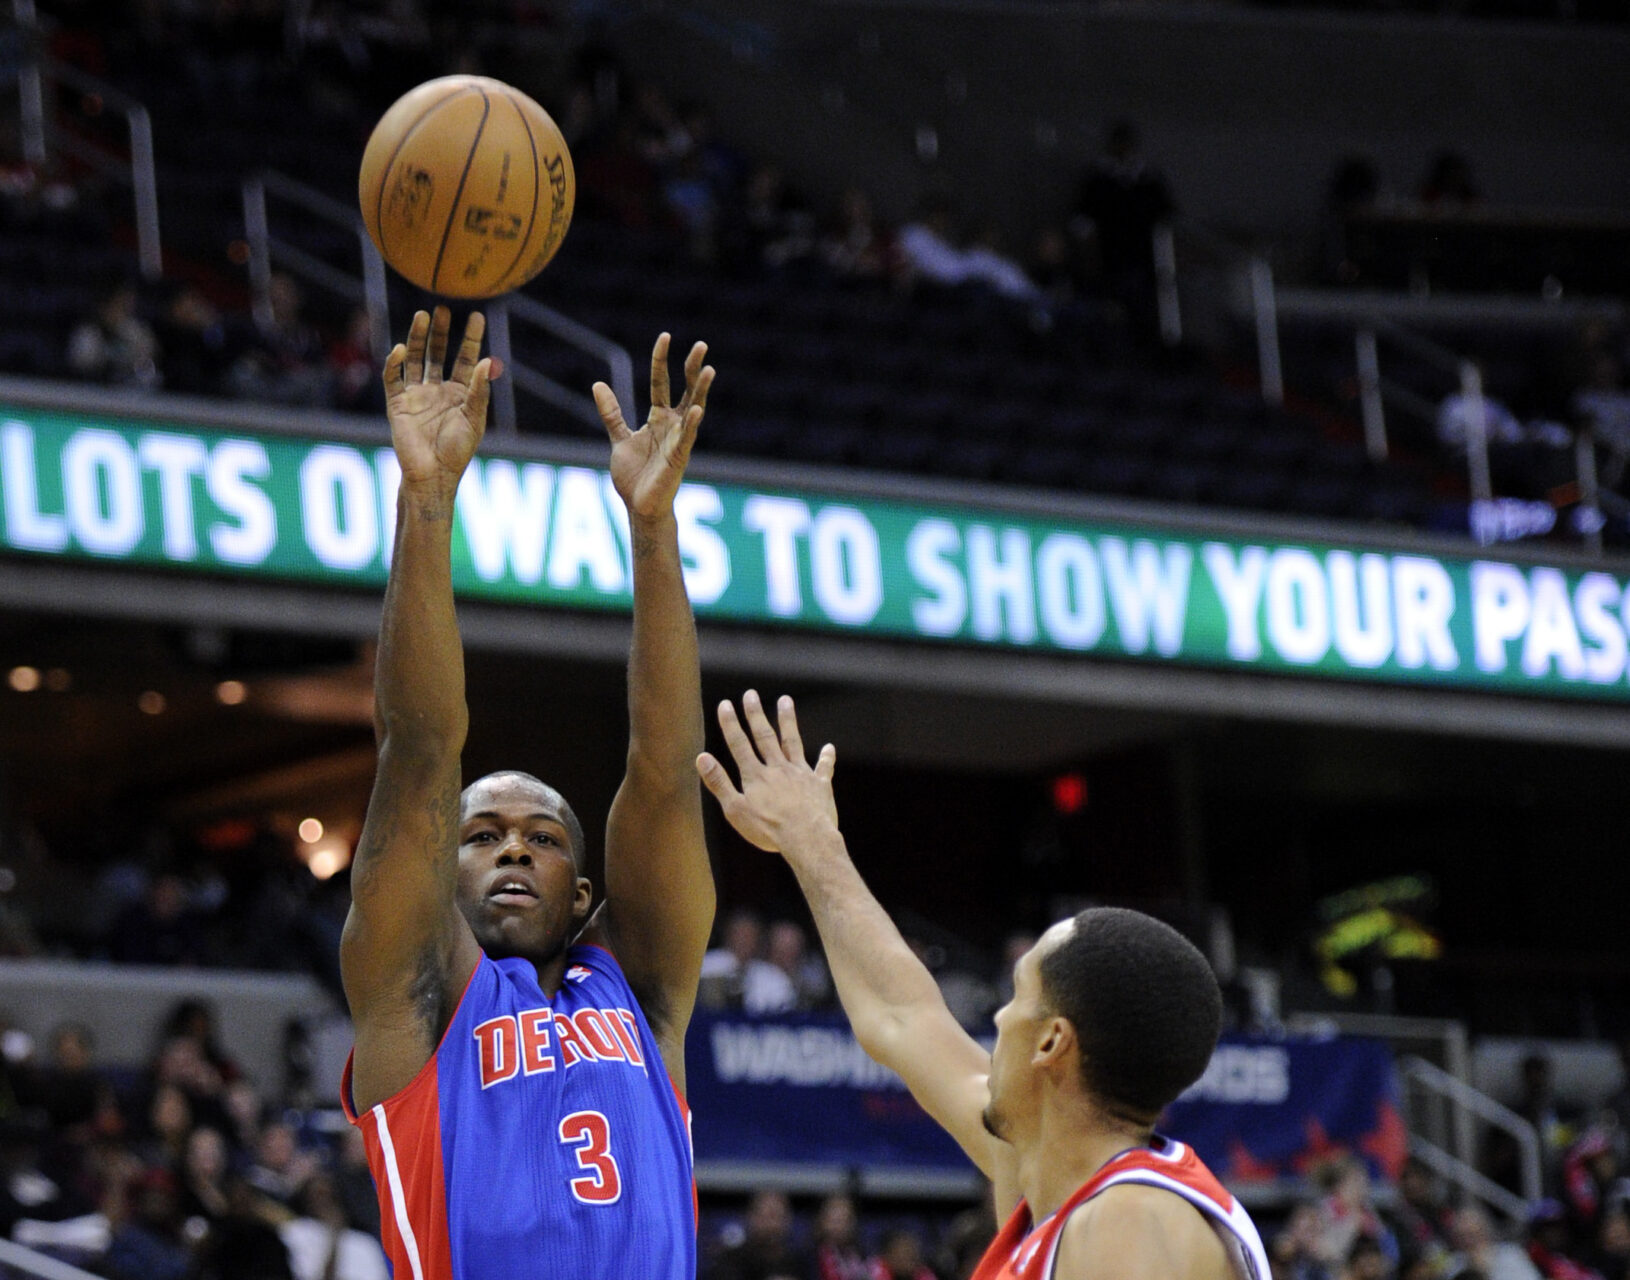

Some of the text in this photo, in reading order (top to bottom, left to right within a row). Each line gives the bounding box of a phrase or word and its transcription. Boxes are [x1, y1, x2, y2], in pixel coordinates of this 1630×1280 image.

[0, 421, 278, 565] LOTS
[743, 495, 884, 625] TO
[906, 520, 1193, 658] SHOW
[1204, 542, 1461, 671] YOUR
[1470, 560, 1630, 685] PAS
[559, 1110, 622, 1205] 3
